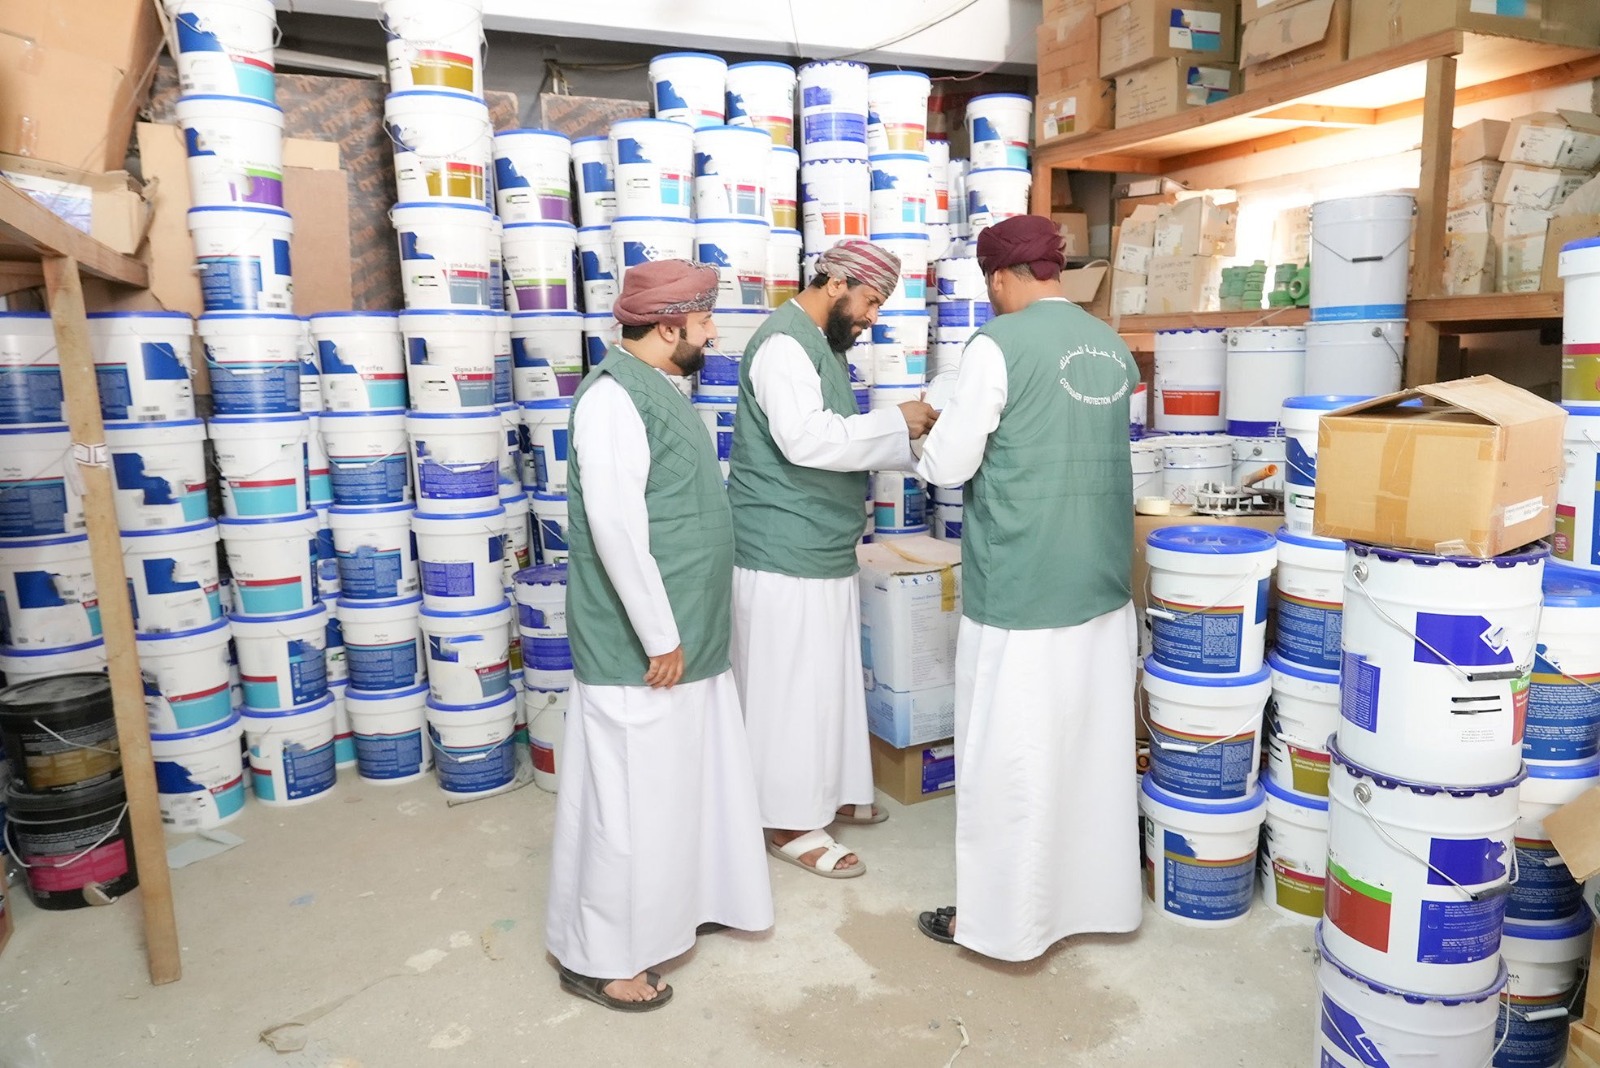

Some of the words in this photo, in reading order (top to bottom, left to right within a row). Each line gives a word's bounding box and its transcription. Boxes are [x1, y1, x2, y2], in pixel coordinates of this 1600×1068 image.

[1059, 377, 1083, 401] CONSUMER
[1083, 395, 1112, 405] PROTECTION
[1111, 377, 1129, 402] AUTHORITY
